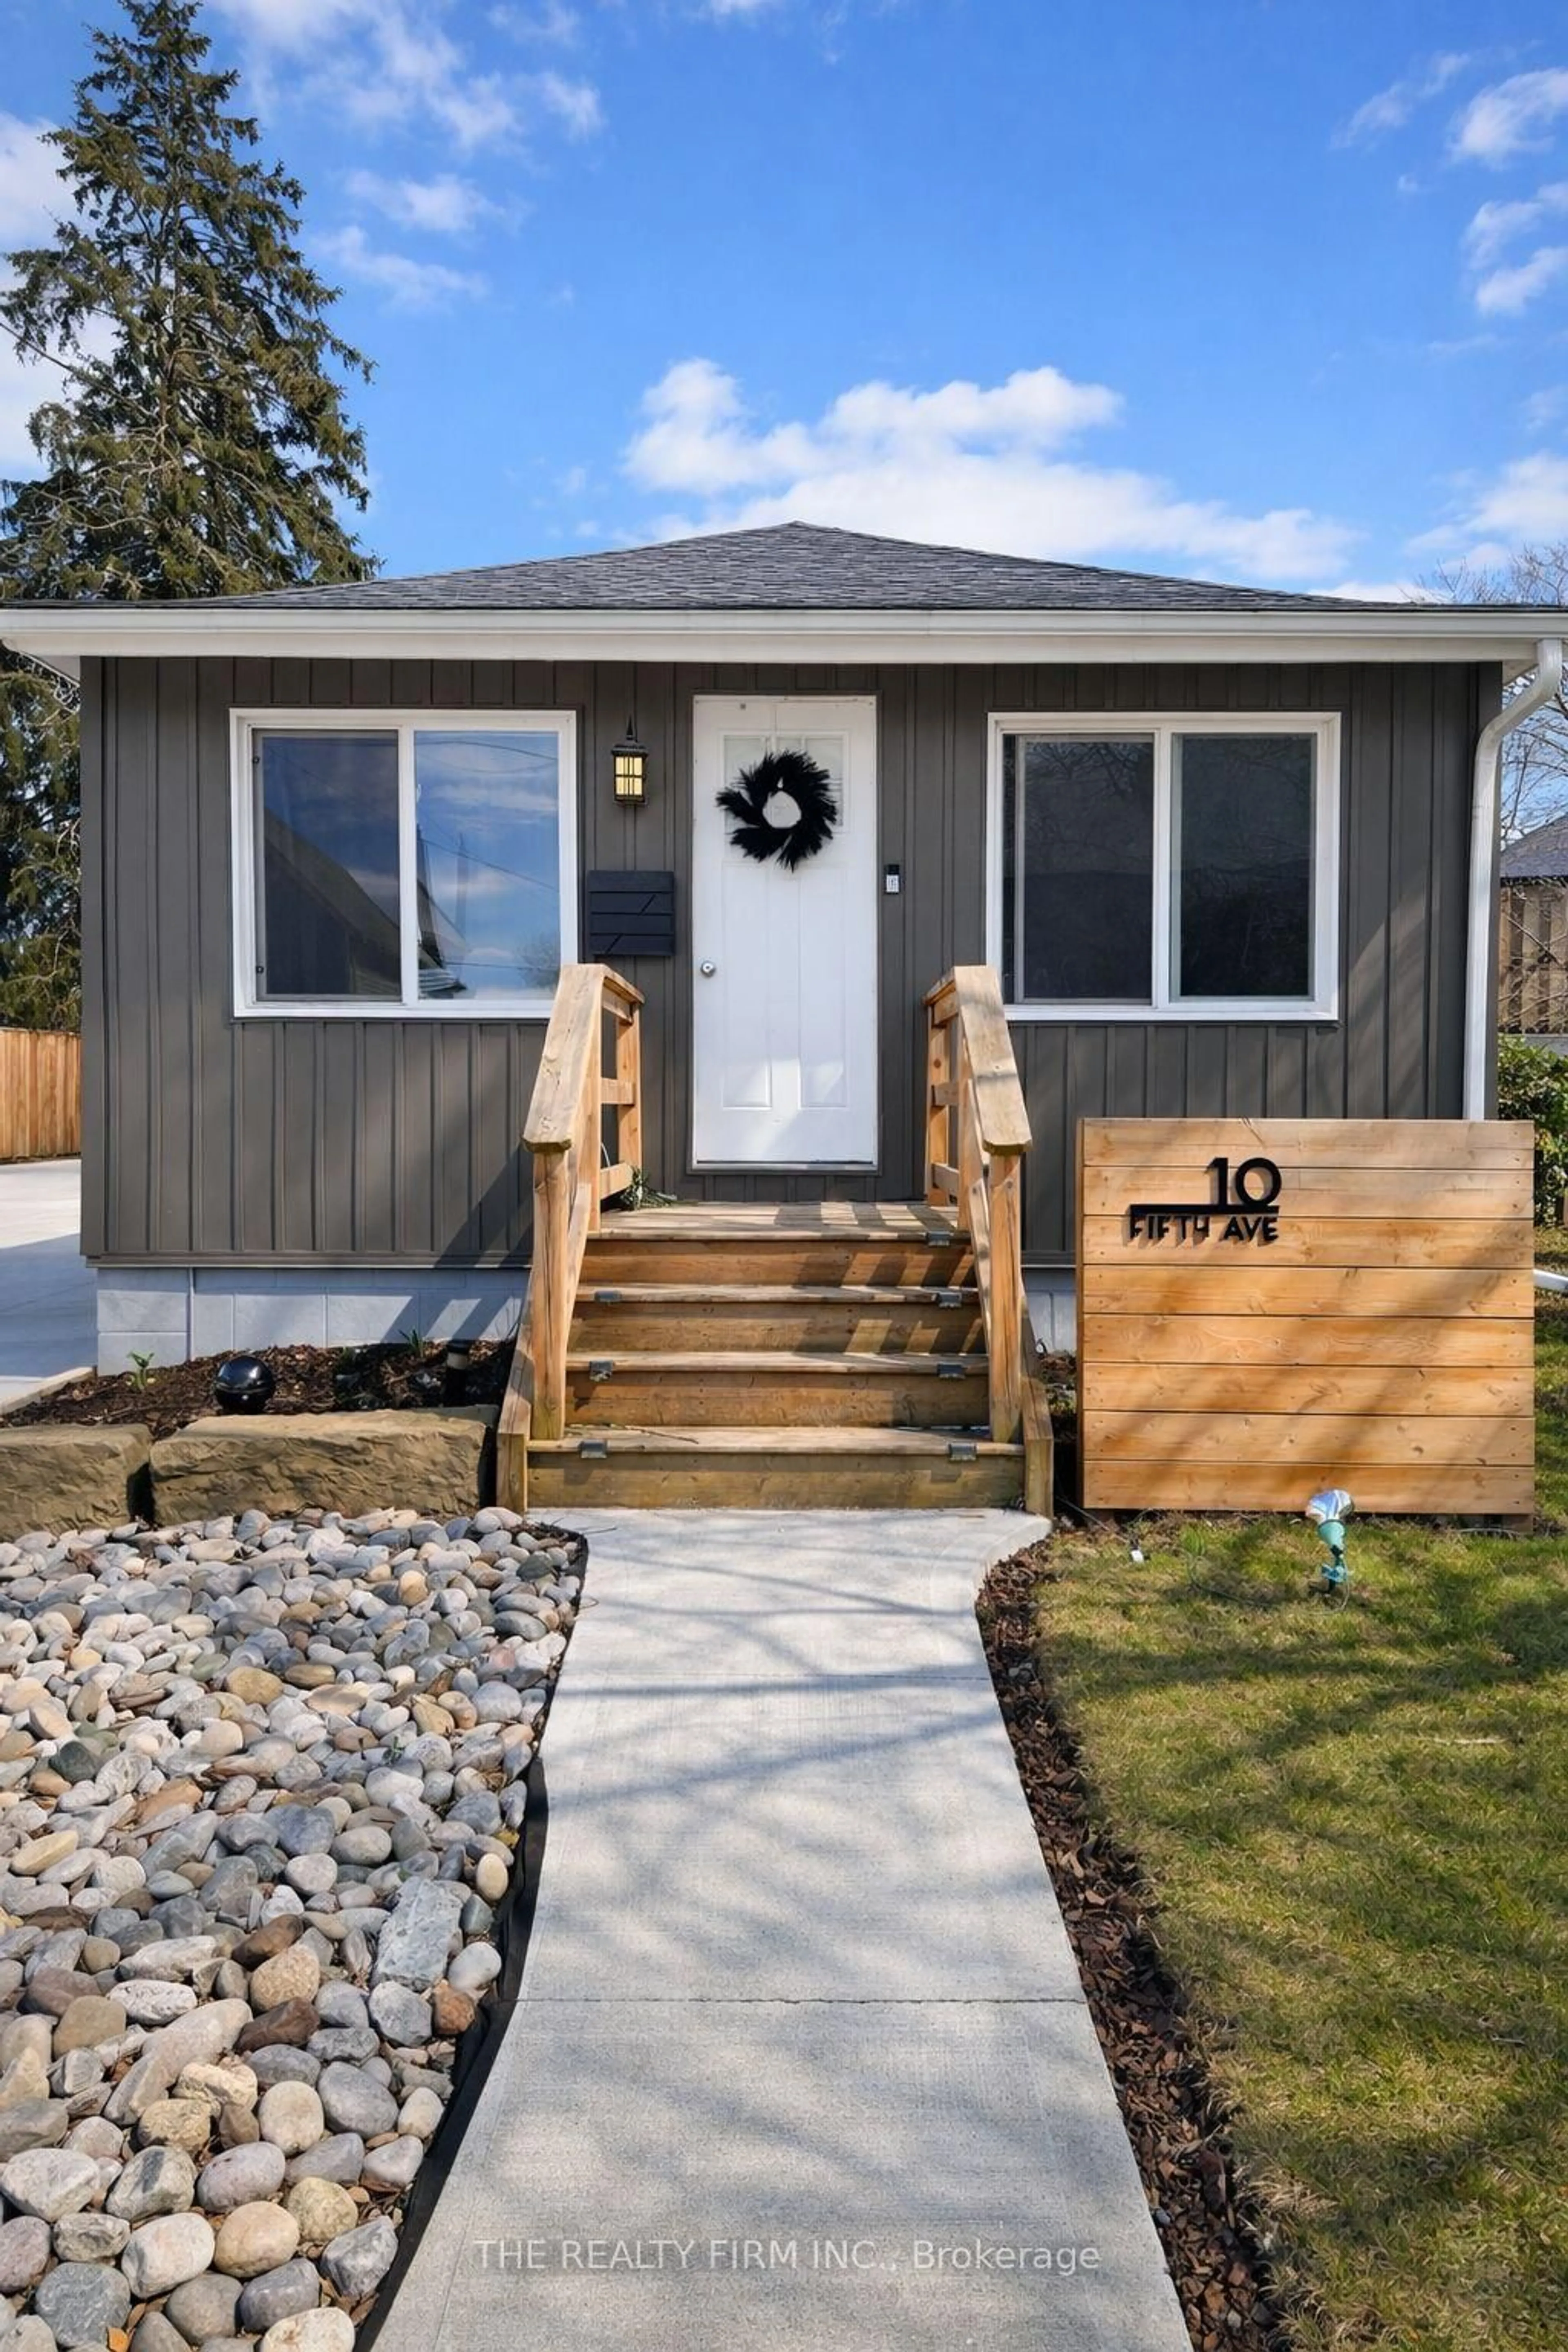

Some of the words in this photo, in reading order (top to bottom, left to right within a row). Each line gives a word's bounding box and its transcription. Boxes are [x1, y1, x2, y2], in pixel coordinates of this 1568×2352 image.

[1205, 1157, 1282, 1207] 10
[1130, 1213, 1210, 1240] FIFTH
[1224, 1214, 1279, 1241] AVE
